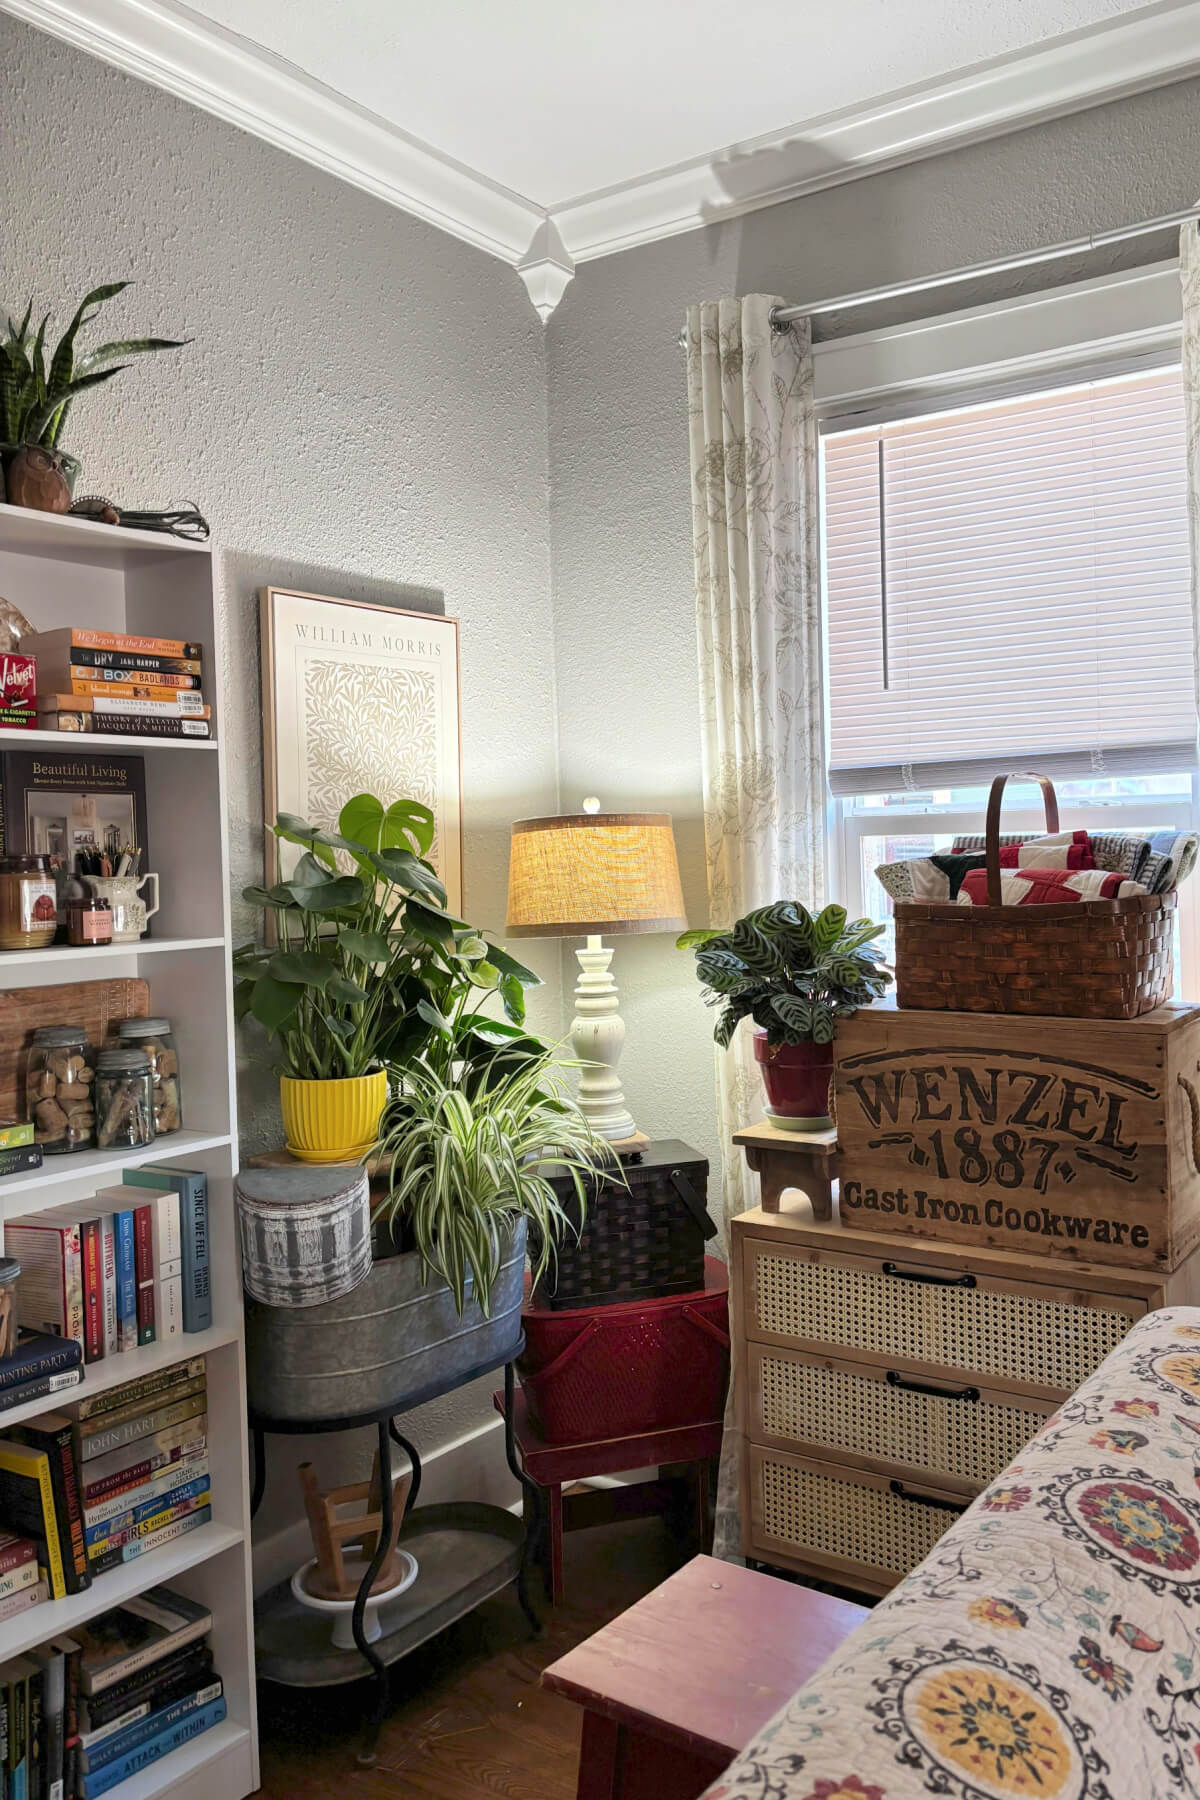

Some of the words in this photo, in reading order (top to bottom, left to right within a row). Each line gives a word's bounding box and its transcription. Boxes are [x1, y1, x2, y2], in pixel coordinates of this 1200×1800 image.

[295, 623, 372, 648] WILLIAM
[382, 636, 442, 657] MORRIS
[94, 652, 114, 666] DRY
[120, 657, 135, 666] JANE
[136, 658, 161, 669] HARPER
[103, 669, 134, 681] BOX
[139, 673, 181, 686] BADLANDS
[95, 715, 131, 723] THEORY
[151, 724, 180, 733] MITCH
[32, 762, 88, 776] Beautiful
[91, 764, 128, 780] Living
[847, 1064, 1139, 1160] WENZEL
[927, 1125, 1060, 1195] 1887
[194, 1188, 205, 1218] SINCE
[843, 1181, 910, 1215] Cast
[913, 1190, 983, 1226] Iron
[983, 1199, 1151, 1249] Cookware
[123, 1217, 131, 1237] JOHN
[195, 1220, 206, 1238] WE
[103, 1232, 114, 1280] BOYFRIEND
[195, 1238, 206, 1261] FELL
[40, 1352, 68, 1369] PARTY
[87, 1431, 121, 1455] JOHN
[122, 1416, 156, 1438] HART
[88, 1503, 123, 1524] Hypnotist's
[120, 1521, 150, 1545] GIRLS
[129, 1545, 141, 1555] THE
[143, 1526, 180, 1549] INNOCENT
[166, 1709, 180, 1722] THE
[124, 1743, 162, 1774] ATTACK
[171, 1715, 206, 1745] WITHIN
